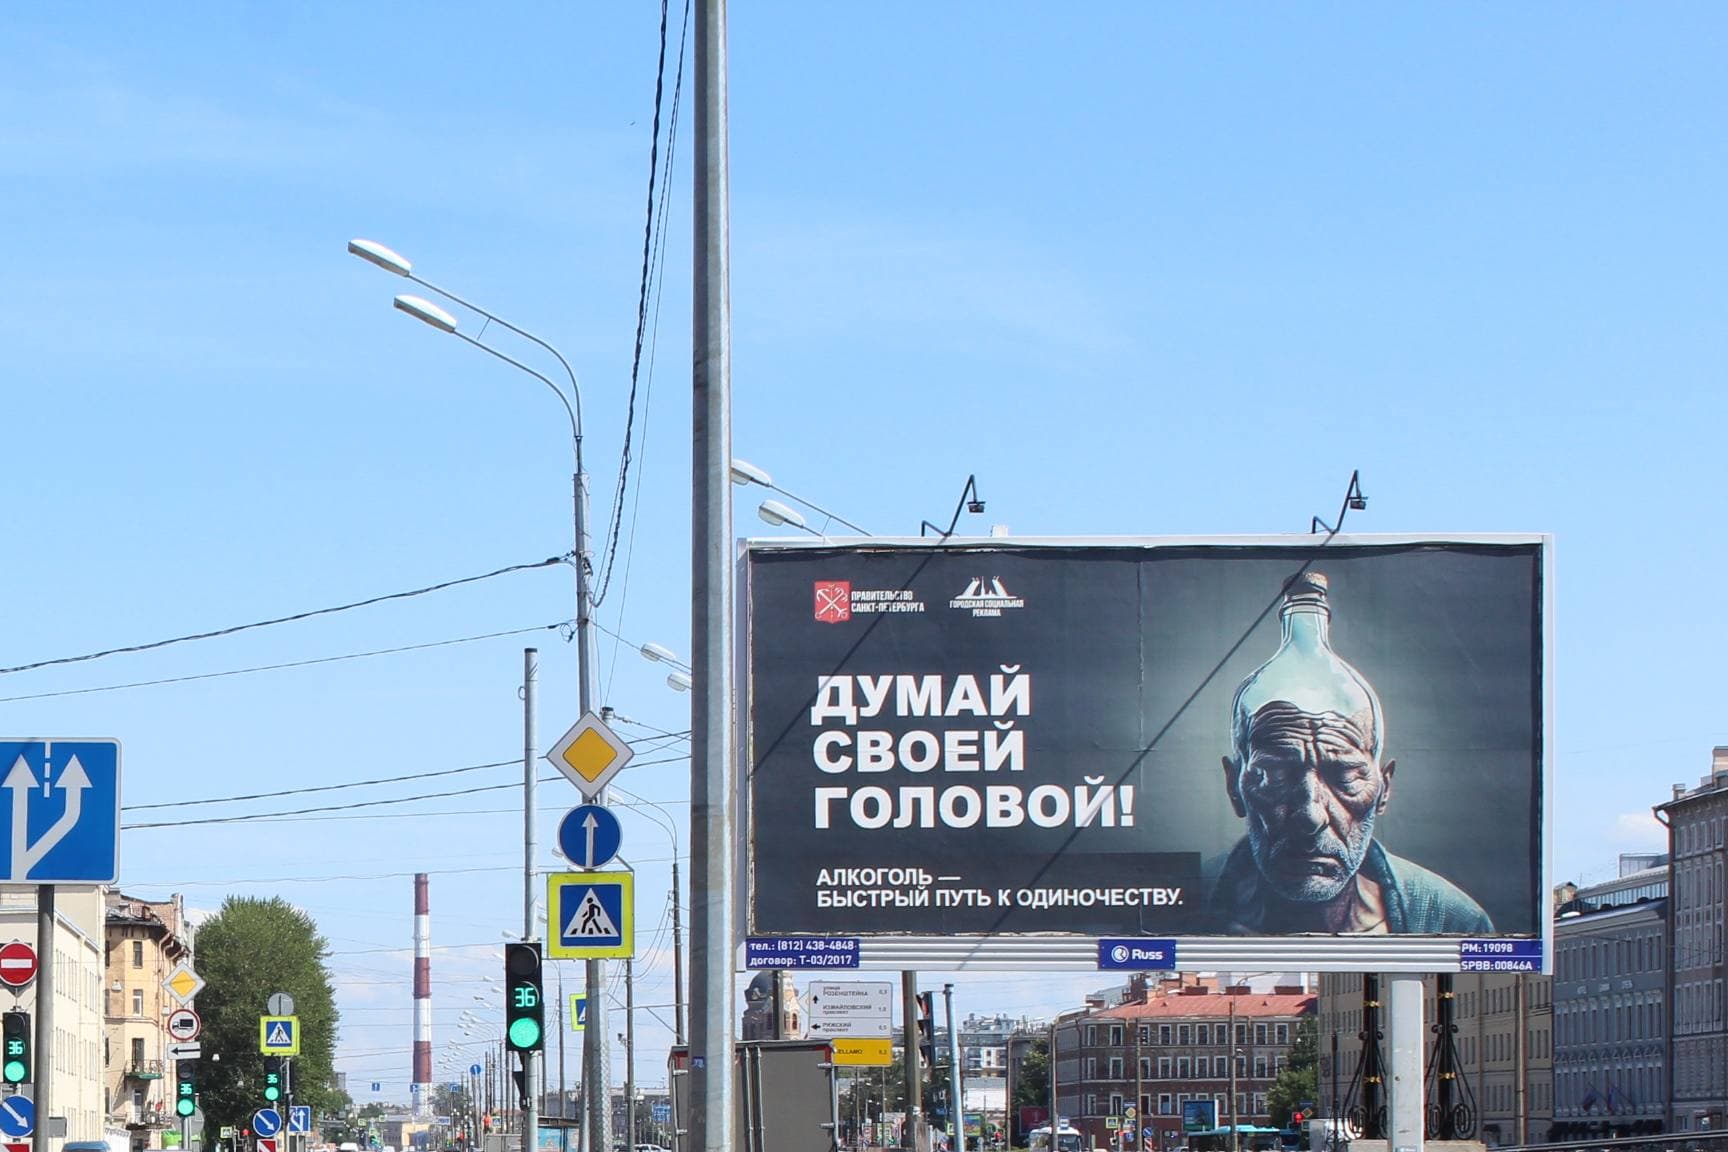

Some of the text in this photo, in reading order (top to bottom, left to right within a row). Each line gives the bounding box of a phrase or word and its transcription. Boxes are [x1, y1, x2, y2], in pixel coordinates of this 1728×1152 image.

[851, 590, 913, 601] ПРАВИТЕЛЬСТВО
[851, 602, 924, 613] САНКТ-ПЕТЕРБУРГА
[950, 599, 1024, 609] ГОРОДСКАЯ СОЦИАЛЬНАЯ
[972, 609, 1001, 617] РЕКЛАМА
[810, 664, 1030, 726] ДУМАЙ
[813, 720, 1024, 774] СВОЕЙ
[815, 775, 1135, 829] ГОЛОВОЙ!
[816, 868, 933, 886] АЛКОГОЛЬ
[817, 886, 1183, 909] БЫСТРЫЙ ПУТЬ К ОДИНОЧЕСТВУ.
[777, 940, 803, 952] (812)
[805, 940, 854, 951] 438-4848
[749, 956, 797, 967] договор:
[514, 987, 536, 1008] 36
[8, 1041, 24, 1055] 36
[180, 1083, 192, 1095] 36
